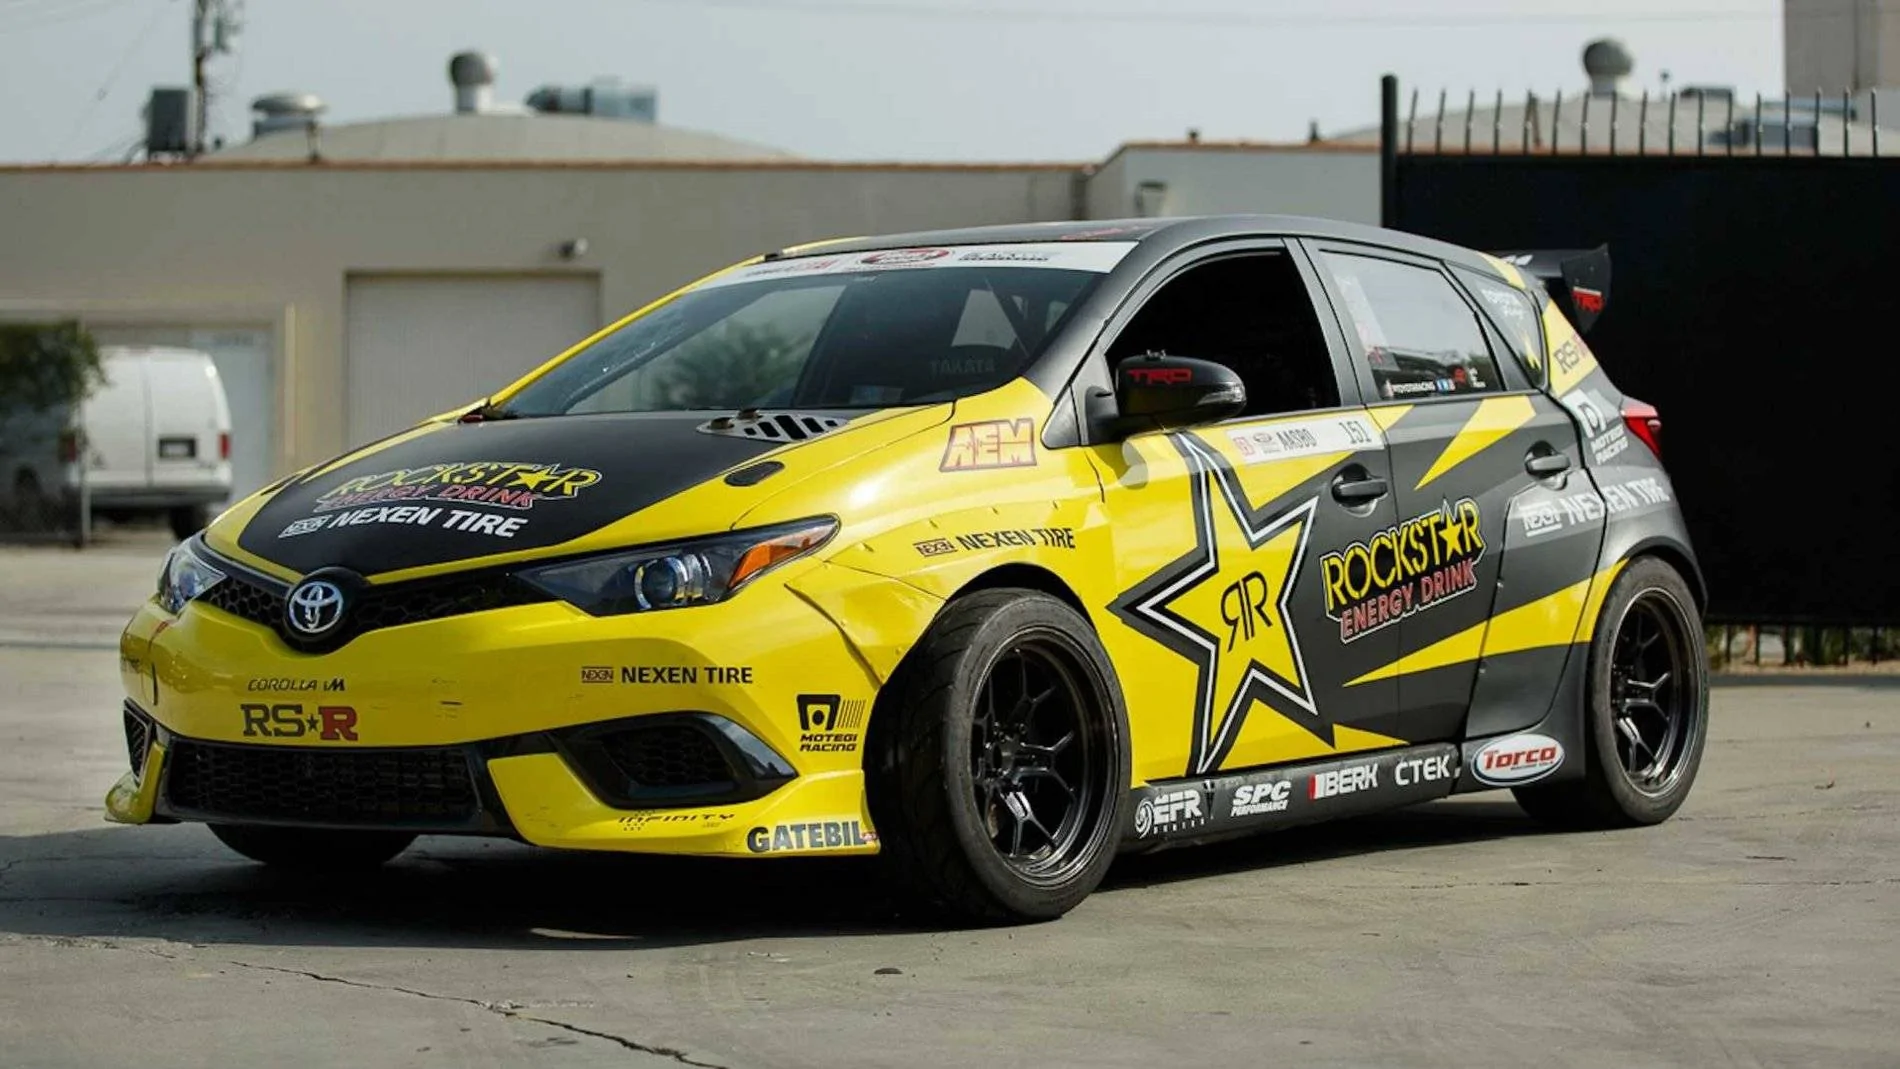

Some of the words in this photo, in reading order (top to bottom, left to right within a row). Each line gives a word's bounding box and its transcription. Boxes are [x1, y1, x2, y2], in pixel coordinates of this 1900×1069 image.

[1128, 368, 1192, 385] TRD
[939, 418, 1037, 472] AEM
[1338, 420, 1374, 445] 151
[438, 484, 535, 507] DRINK
[1559, 484, 1642, 526] NEXEN
[328, 506, 443, 529] NEXEN
[442, 509, 528, 538] TIRE
[956, 533, 1036, 551] NEXEN
[1032, 528, 1076, 549] TIRE
[1341, 583, 1415, 638] ENERGY
[1420, 558, 1475, 604] DRINK
[247, 678, 318, 692] COROLLA
[621, 667, 697, 683] NEXEN
[704, 667, 753, 683] TIRE
[799, 733, 858, 742] MOTEGI
[799, 743, 857, 752] RACING
[1395, 755, 1450, 786] CTEK
[1484, 747, 1556, 770] Torco
[1325, 763, 1379, 797] BERK
[1232, 781, 1292, 806] SPC
[1153, 788, 1203, 825] EFR
[747, 821, 867, 853] GATEBIL
